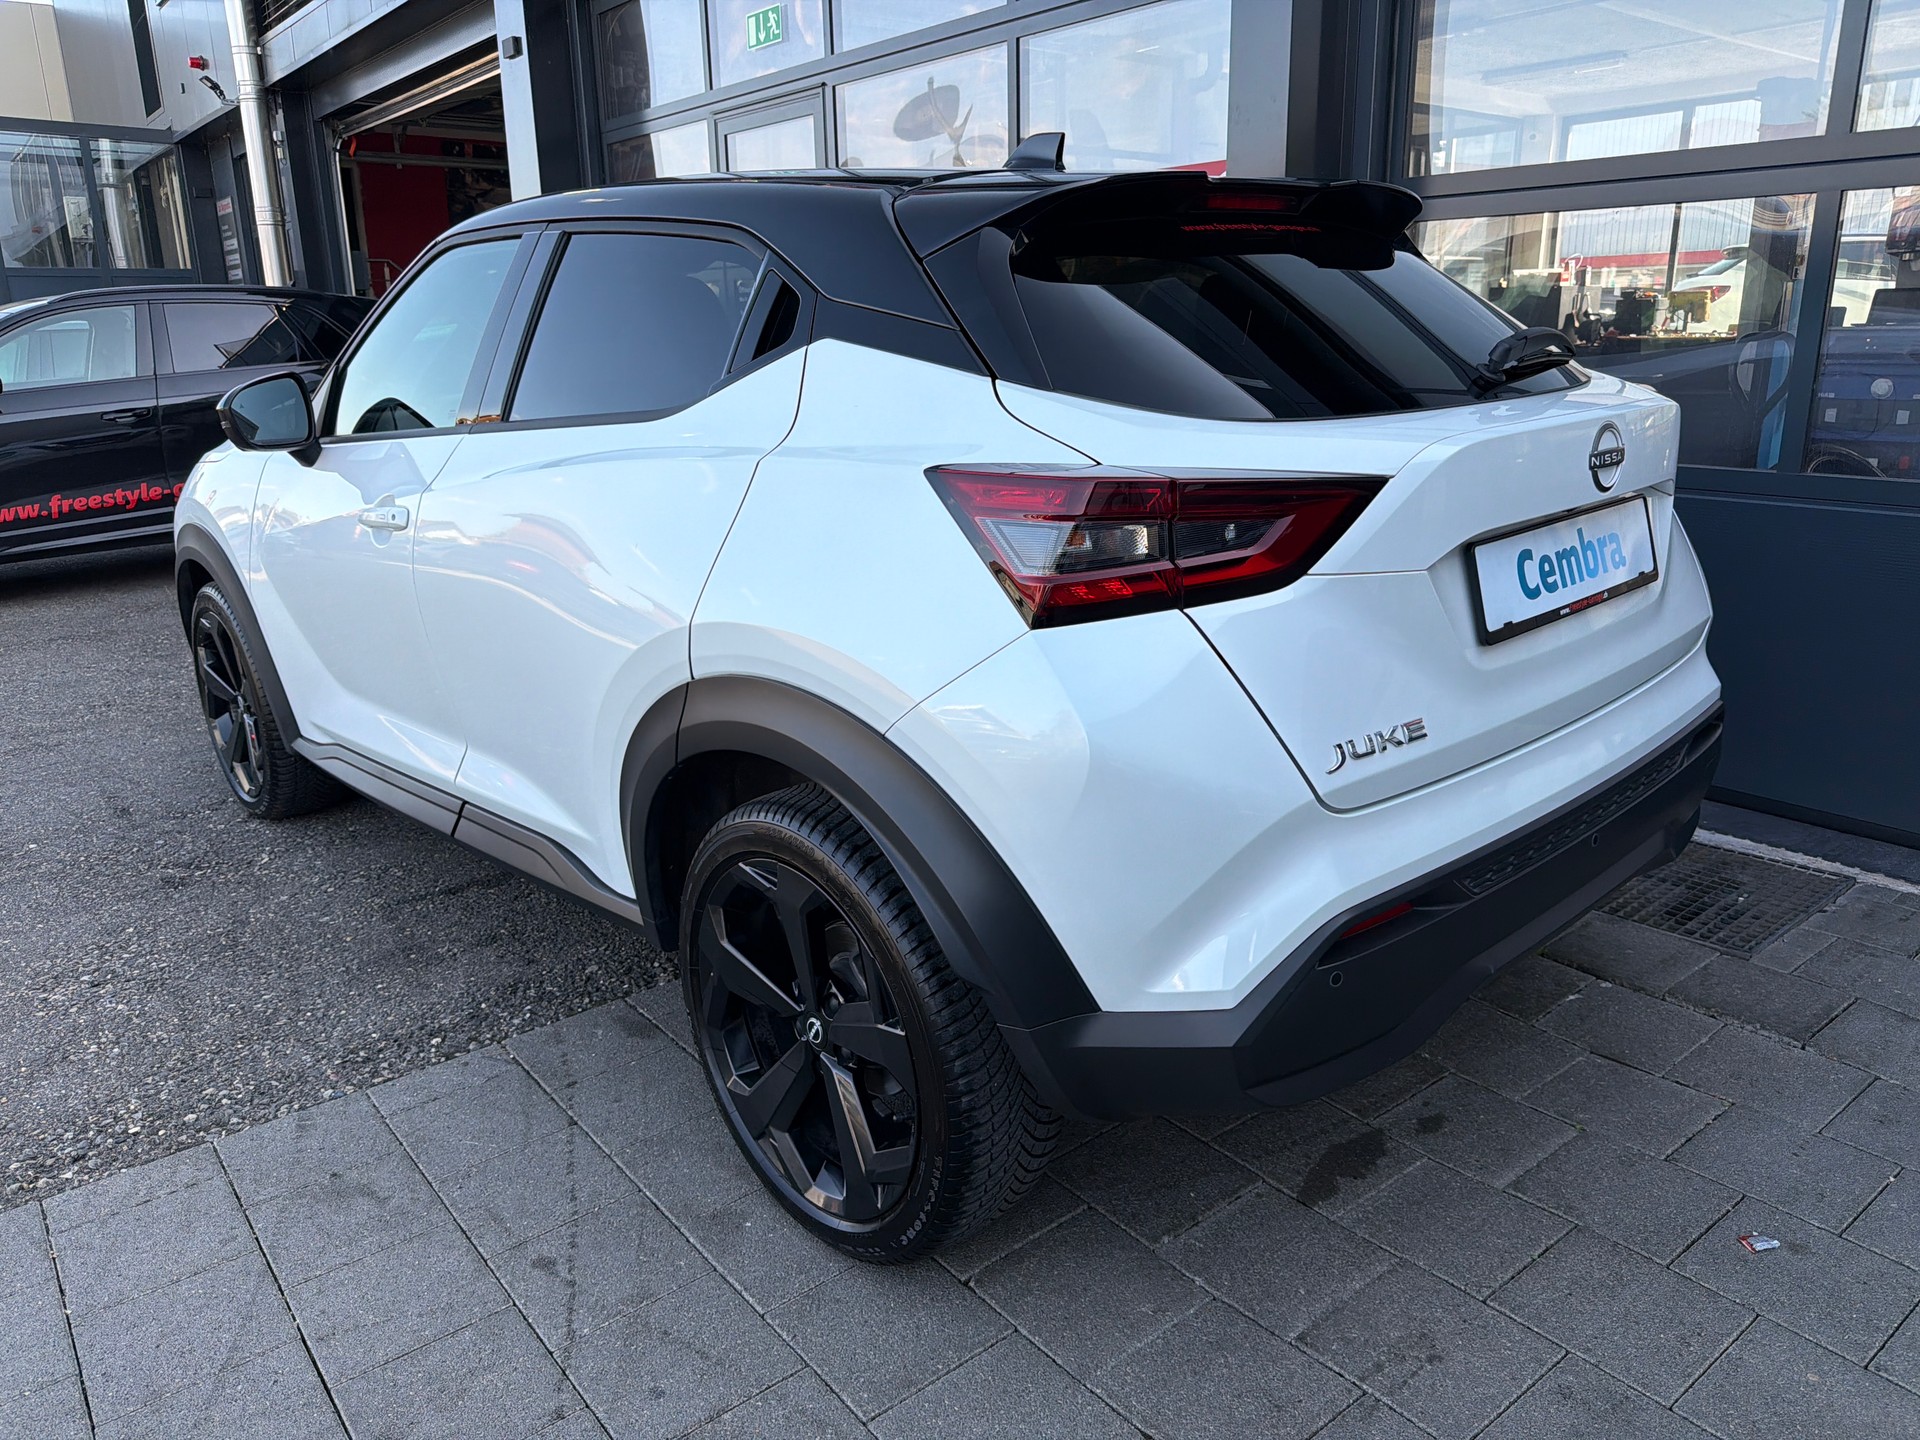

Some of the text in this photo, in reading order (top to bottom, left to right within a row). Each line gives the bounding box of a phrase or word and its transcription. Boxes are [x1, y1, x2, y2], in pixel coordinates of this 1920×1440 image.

[1591, 451, 1624, 467] NISSA
[1516, 527, 1626, 600] Cembra
[1325, 717, 1428, 775] JUKE
